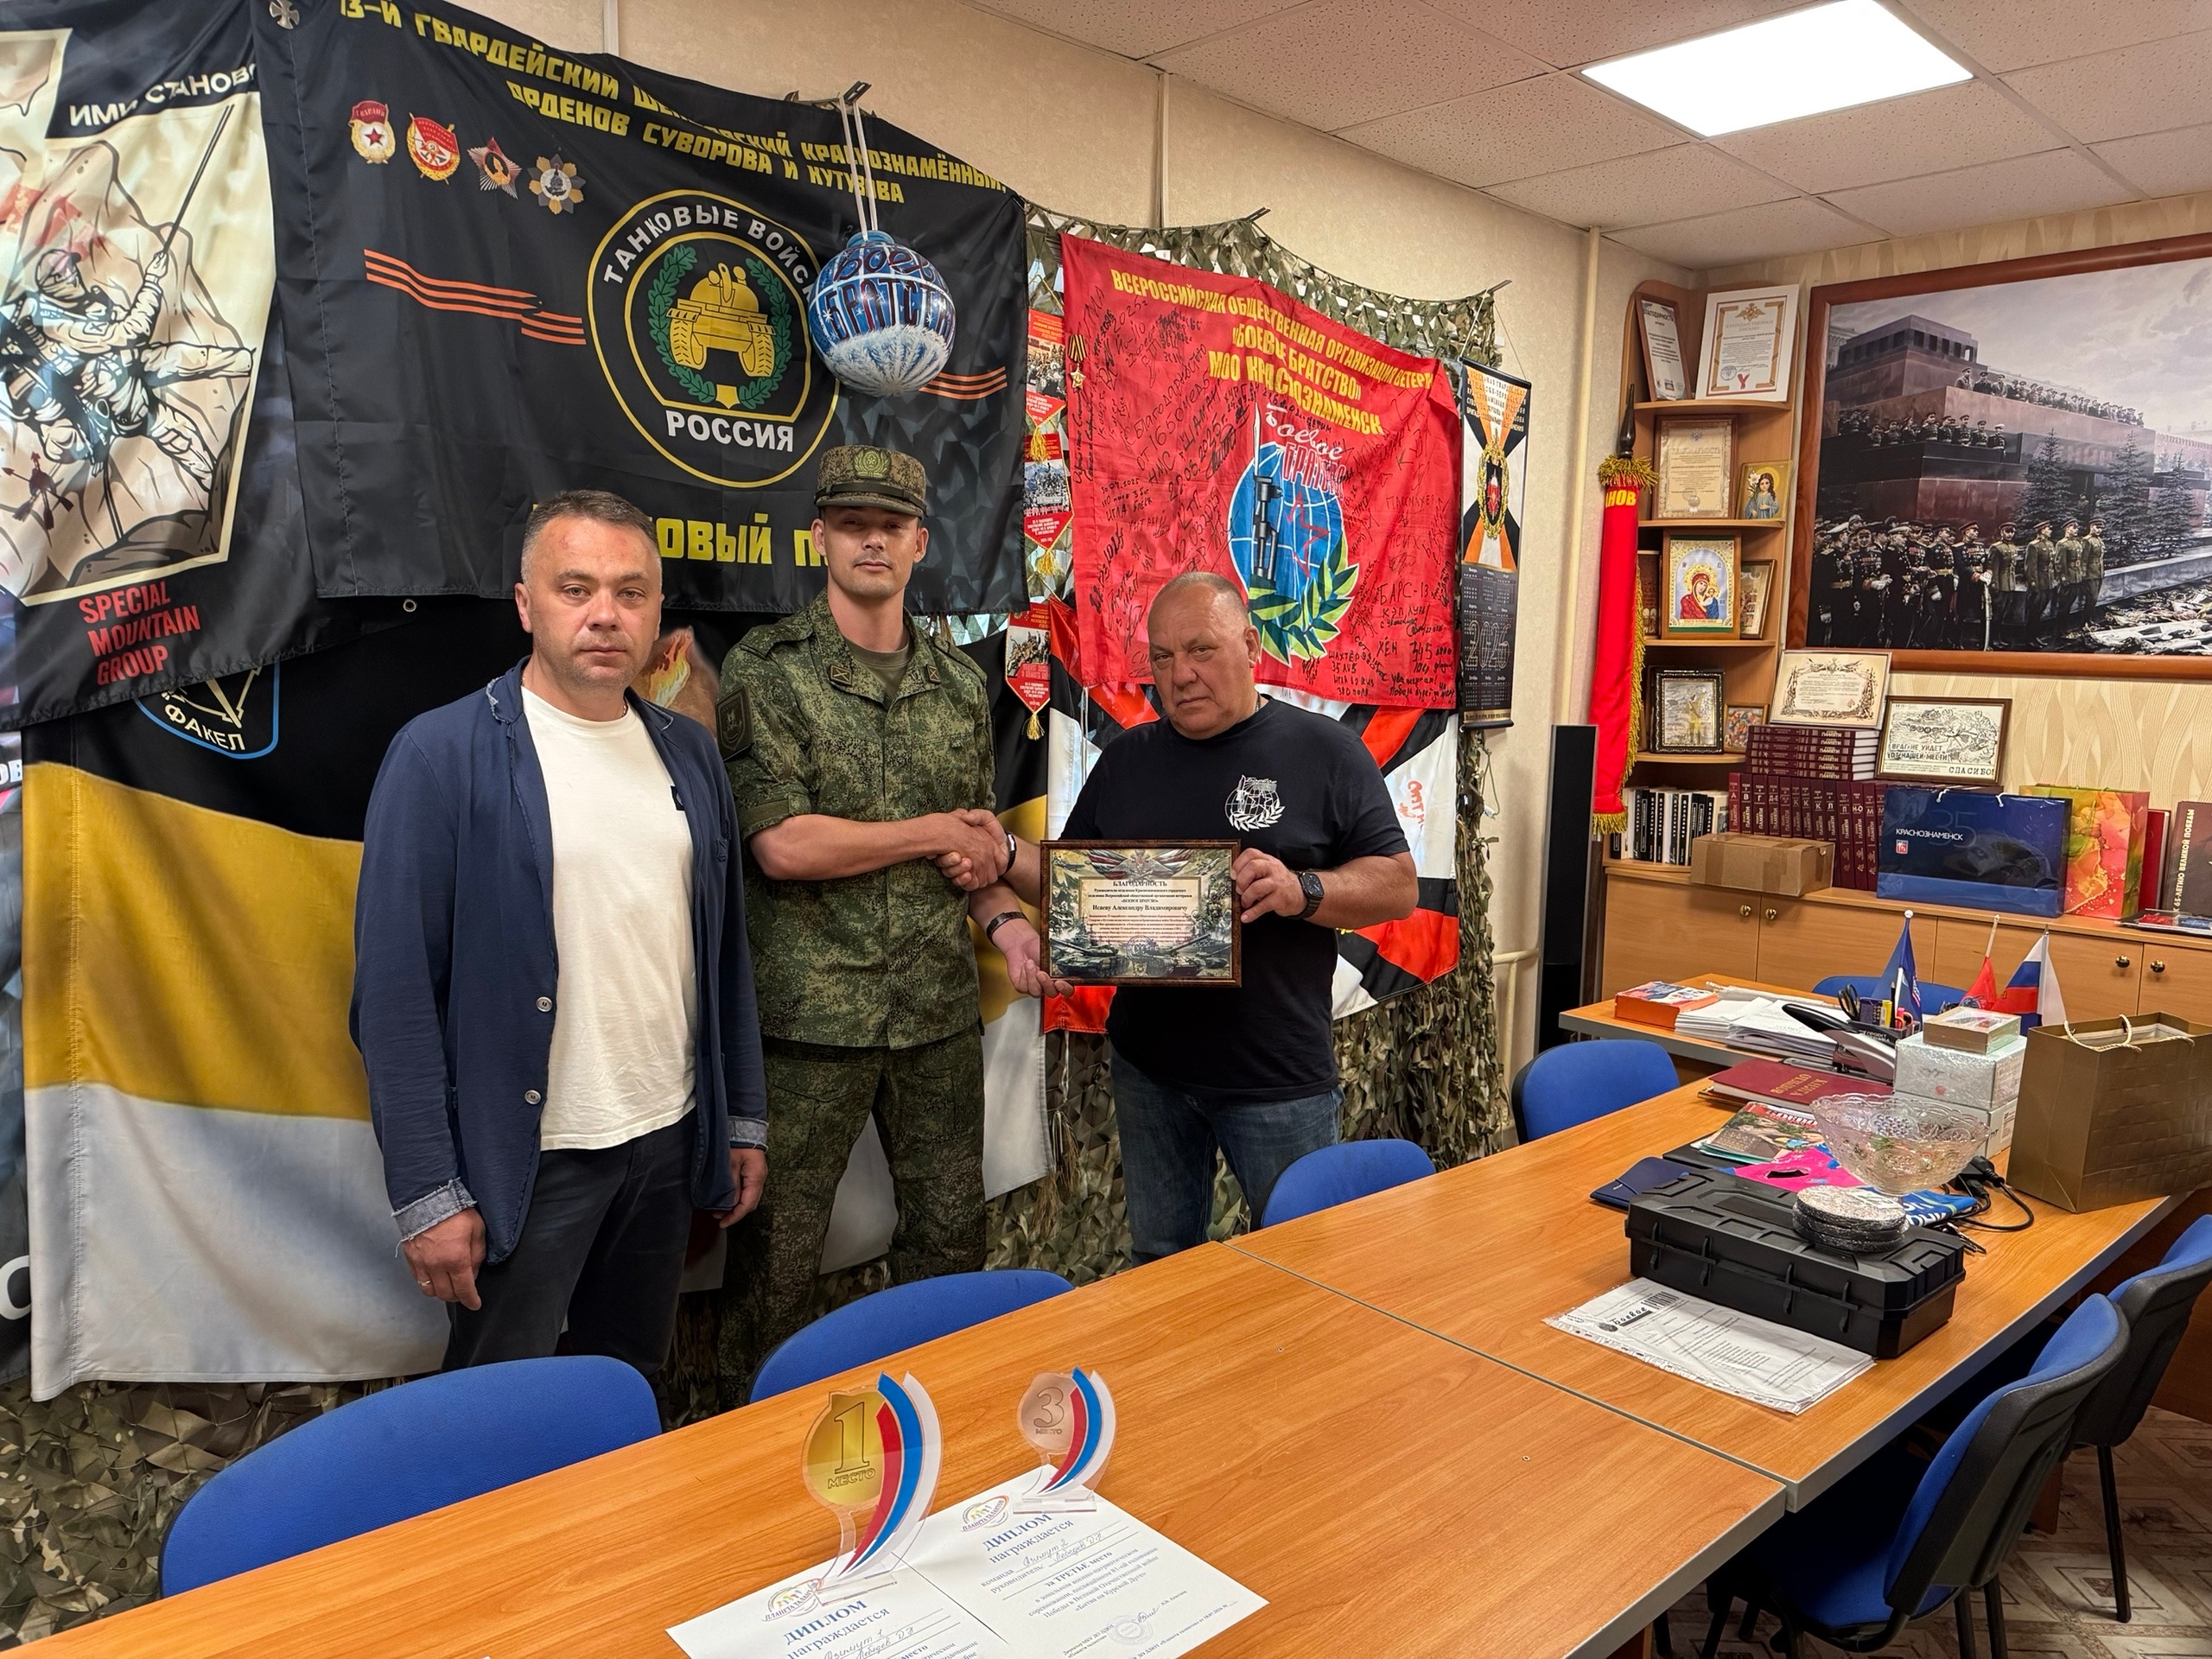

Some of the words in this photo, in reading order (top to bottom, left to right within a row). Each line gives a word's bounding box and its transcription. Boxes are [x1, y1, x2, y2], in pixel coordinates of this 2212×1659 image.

[415, 13, 620, 99] ГВАРДЕЙСКИЙ
[505, 80, 630, 137] ОРДЕНОВ
[642, 122, 772, 175] СУВОРОВА
[782, 158, 798, 180] И
[604, 204, 739, 286] ТАНКОВЫЕ
[1110, 269, 1226, 314] ВСЕРОССИЙСКАЯ
[1228, 296, 1325, 353] ОБЩЕСТВЕННАЯ
[1325, 339, 1399, 385] ОРГАНИЗАЦИЯ
[1209, 351, 1241, 381] МОО
[665, 410, 794, 453] РОССИЯ
[649, 512, 772, 566] ОВЫЙ
[79, 581, 171, 624] SPECIAL
[88, 605, 200, 657] MOUNTAIN
[97, 645, 168, 686] GROUP
[164, 704, 246, 751] ФАКЕЛ
[1948, 766, 1995, 777] СПАСИБО!
[1896, 828, 1963, 842] КРАСНОЗНАМЕНСК
[2178, 839, 2190, 871] ВЕЛИКОЙ
[2184, 809, 2195, 838] ПОБЕДЫ
[1033, 1387, 1065, 1428] 3
[835, 1402, 870, 1474] 1
[827, 1467, 876, 1489] МЕСТО
[982, 1514, 1053, 1552] ДИПЛОМ
[989, 1520, 1074, 1564] награждается
[981, 1568, 1014, 1587] команда
[1053, 1562, 1090, 1583] ТРЕТЬЕ
[1090, 1552, 1113, 1567] место
[784, 1599, 868, 1646] ДИПЛОМ
[786, 1608, 891, 1659] награждается
